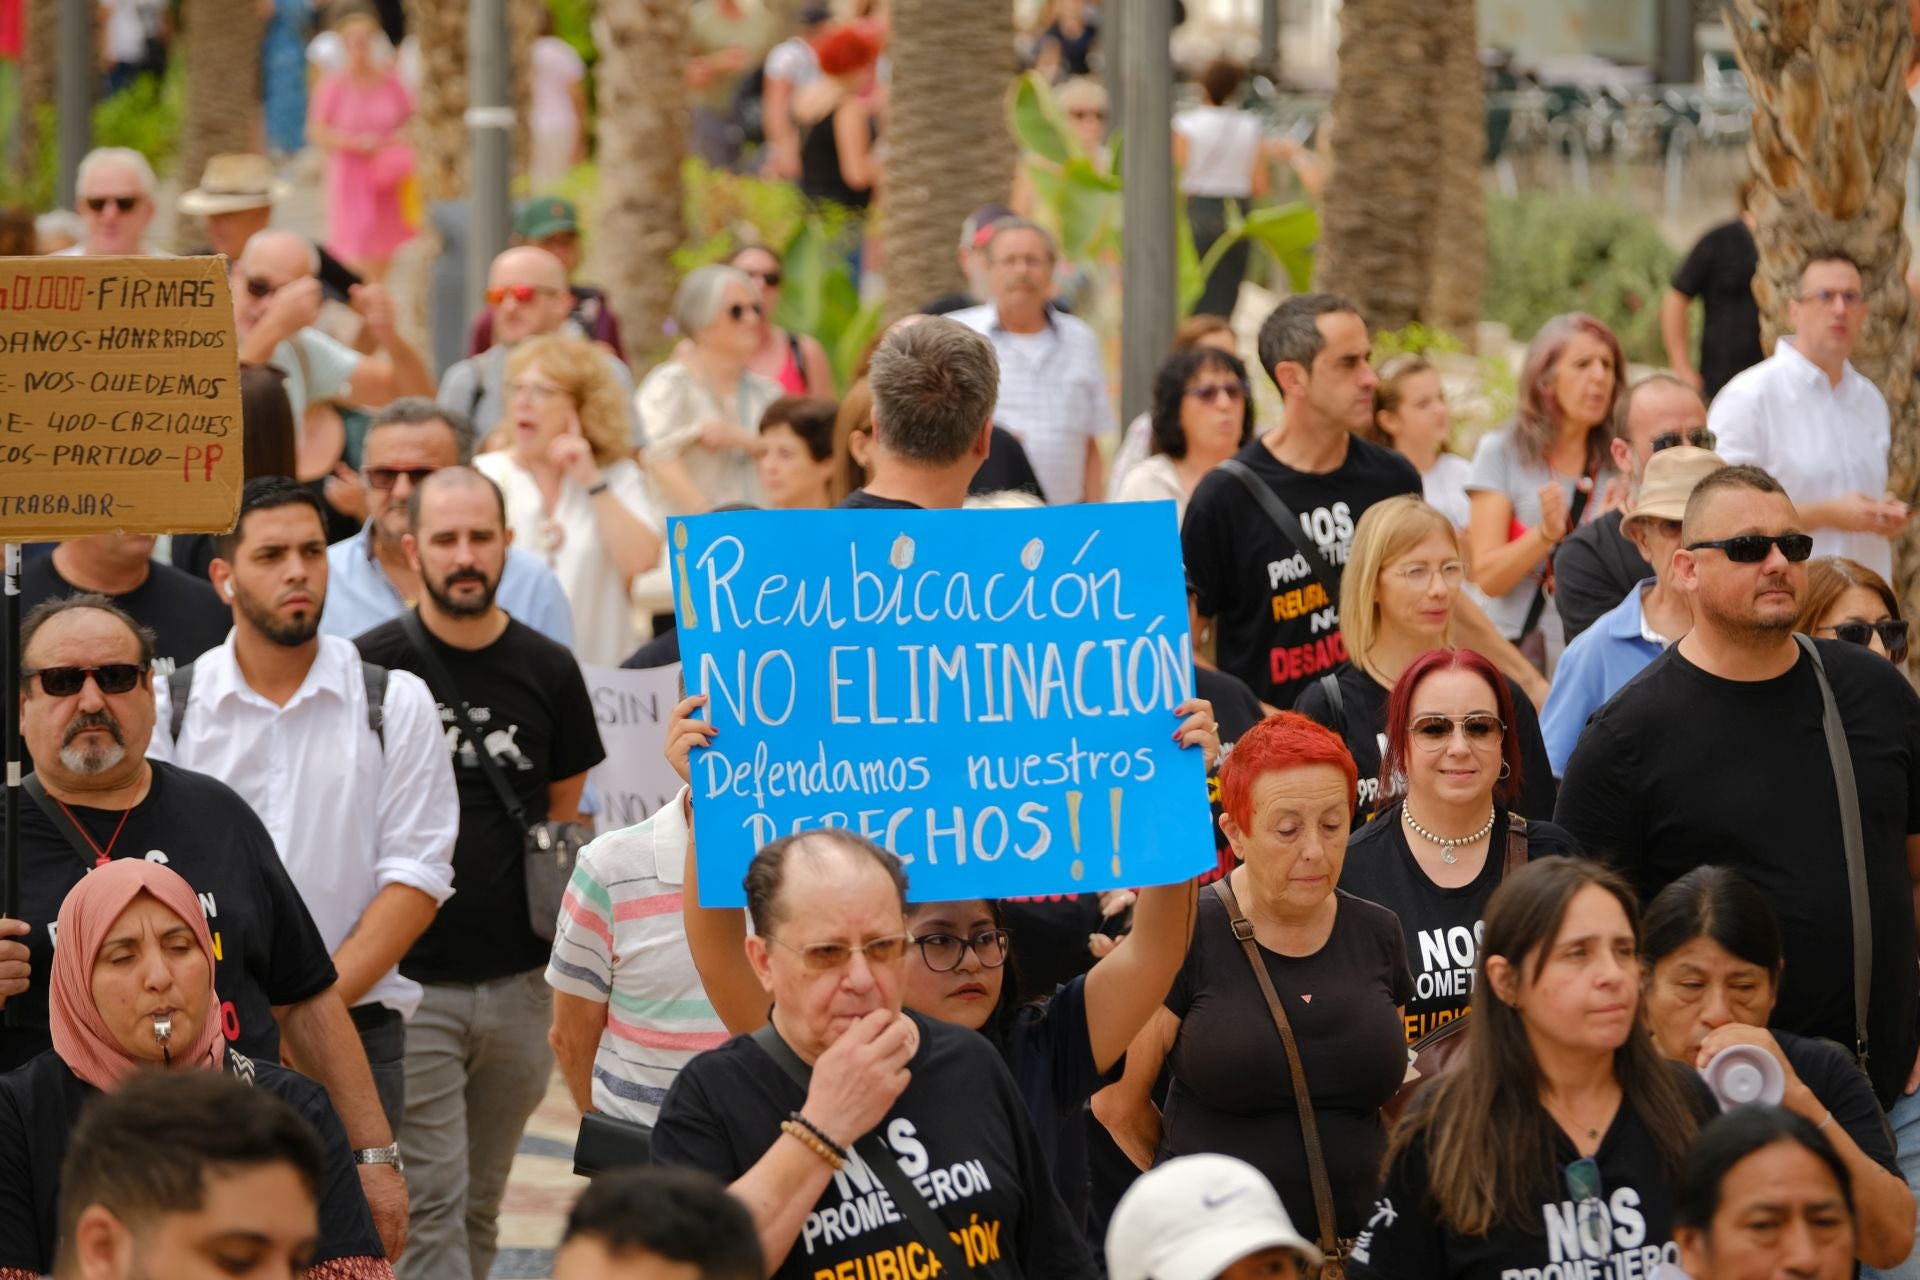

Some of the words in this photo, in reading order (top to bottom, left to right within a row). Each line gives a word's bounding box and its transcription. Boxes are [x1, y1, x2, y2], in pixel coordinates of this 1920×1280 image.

[593, 685, 659, 726] SIN
[701, 648, 796, 726] NO
[829, 616, 1194, 725] ELIMINACIÓN
[698, 740, 931, 809] Defendamos
[968, 738, 1156, 791] nuestros
[832, 1117, 930, 1201] NS
[1542, 1186, 1647, 1263] NOS
